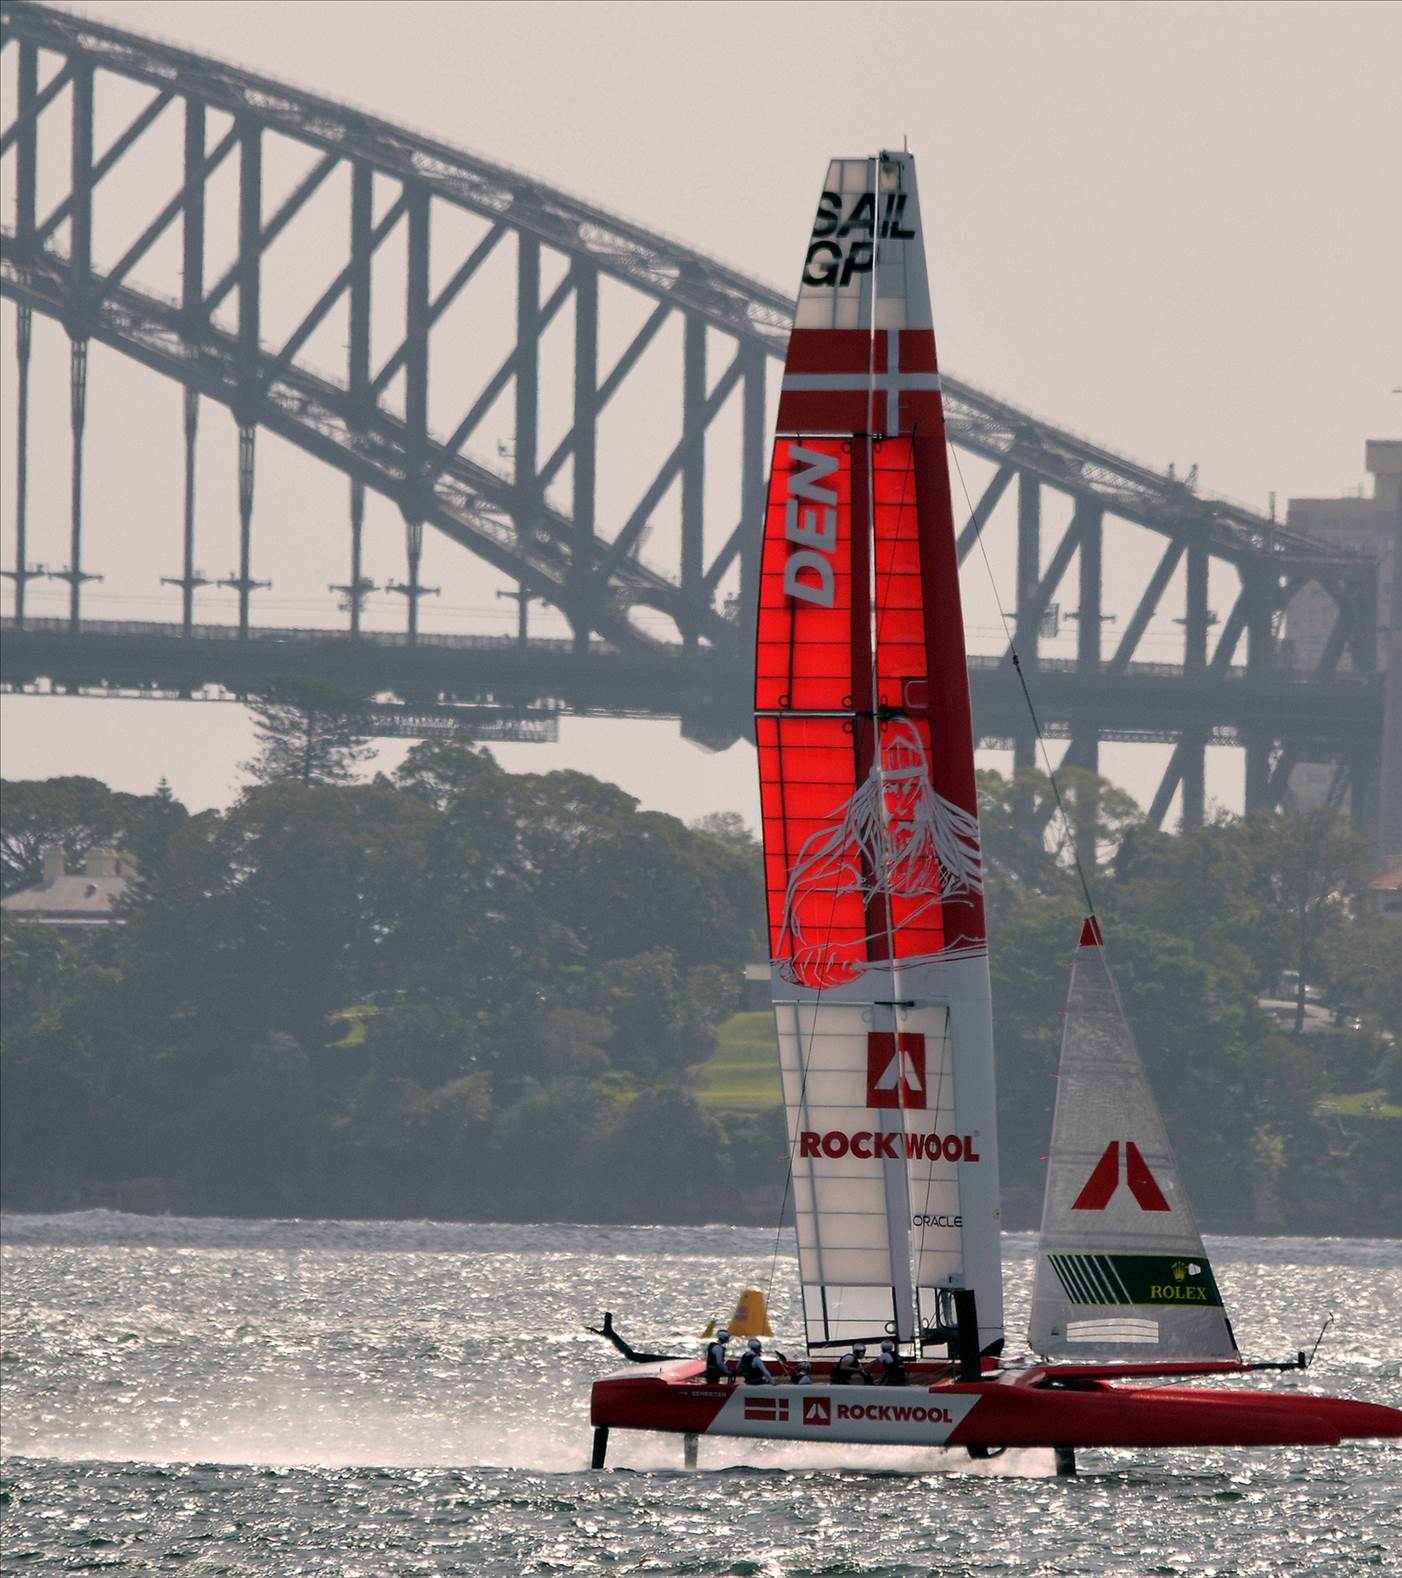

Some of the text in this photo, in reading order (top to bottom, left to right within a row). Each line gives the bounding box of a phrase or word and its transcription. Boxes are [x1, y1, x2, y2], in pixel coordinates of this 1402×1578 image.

[812, 191, 915, 240] SAIL
[802, 240, 875, 287] GP
[784, 444, 840, 609] DEN
[800, 1131, 980, 1163] ROCKWOOL
[912, 1215, 963, 1228] ORACLE
[1151, 1285, 1207, 1300] ROLEX
[837, 1404, 952, 1423] ROCKWOOL
